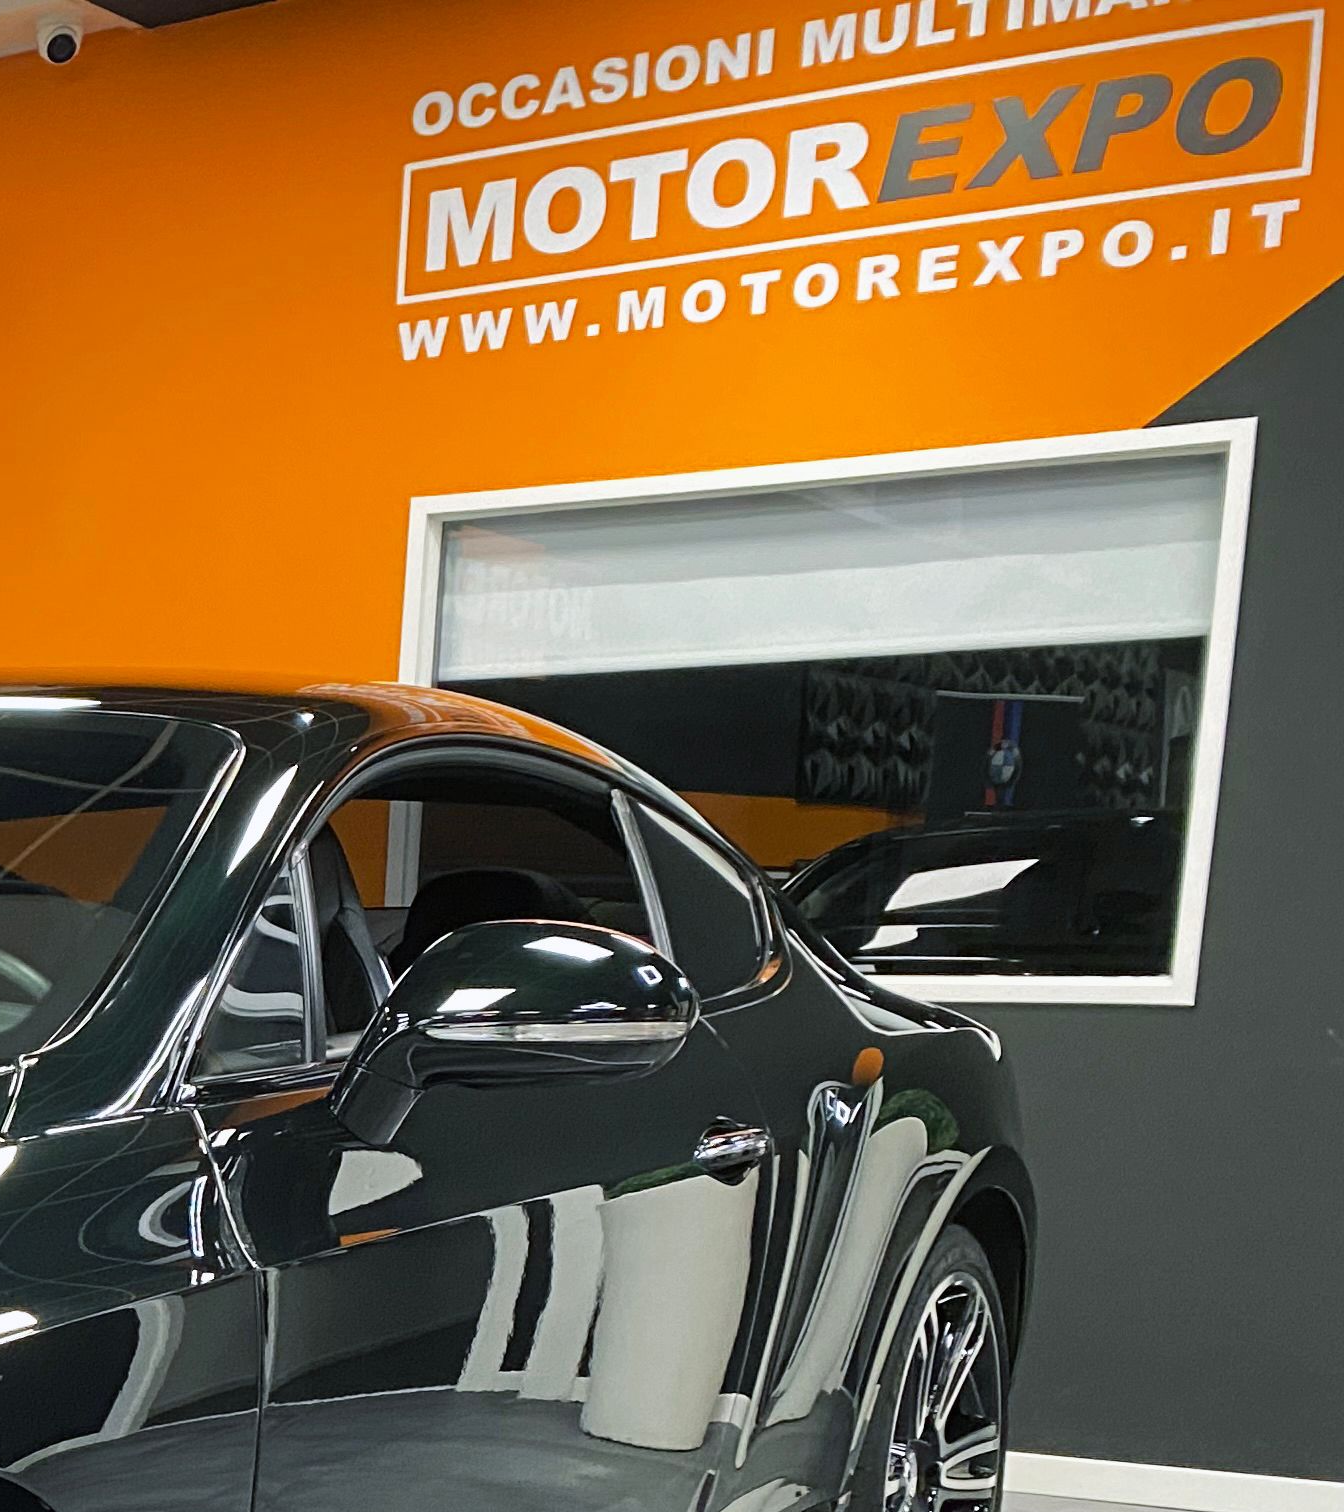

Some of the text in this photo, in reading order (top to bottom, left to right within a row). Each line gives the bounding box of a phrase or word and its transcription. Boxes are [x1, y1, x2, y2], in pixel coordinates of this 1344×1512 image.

[412, 28, 776, 136] OCCASIONI
[424, 56, 1284, 273] MOTOREXPO
[397, 199, 1301, 361] WWW.MOTOREXPO.IT
